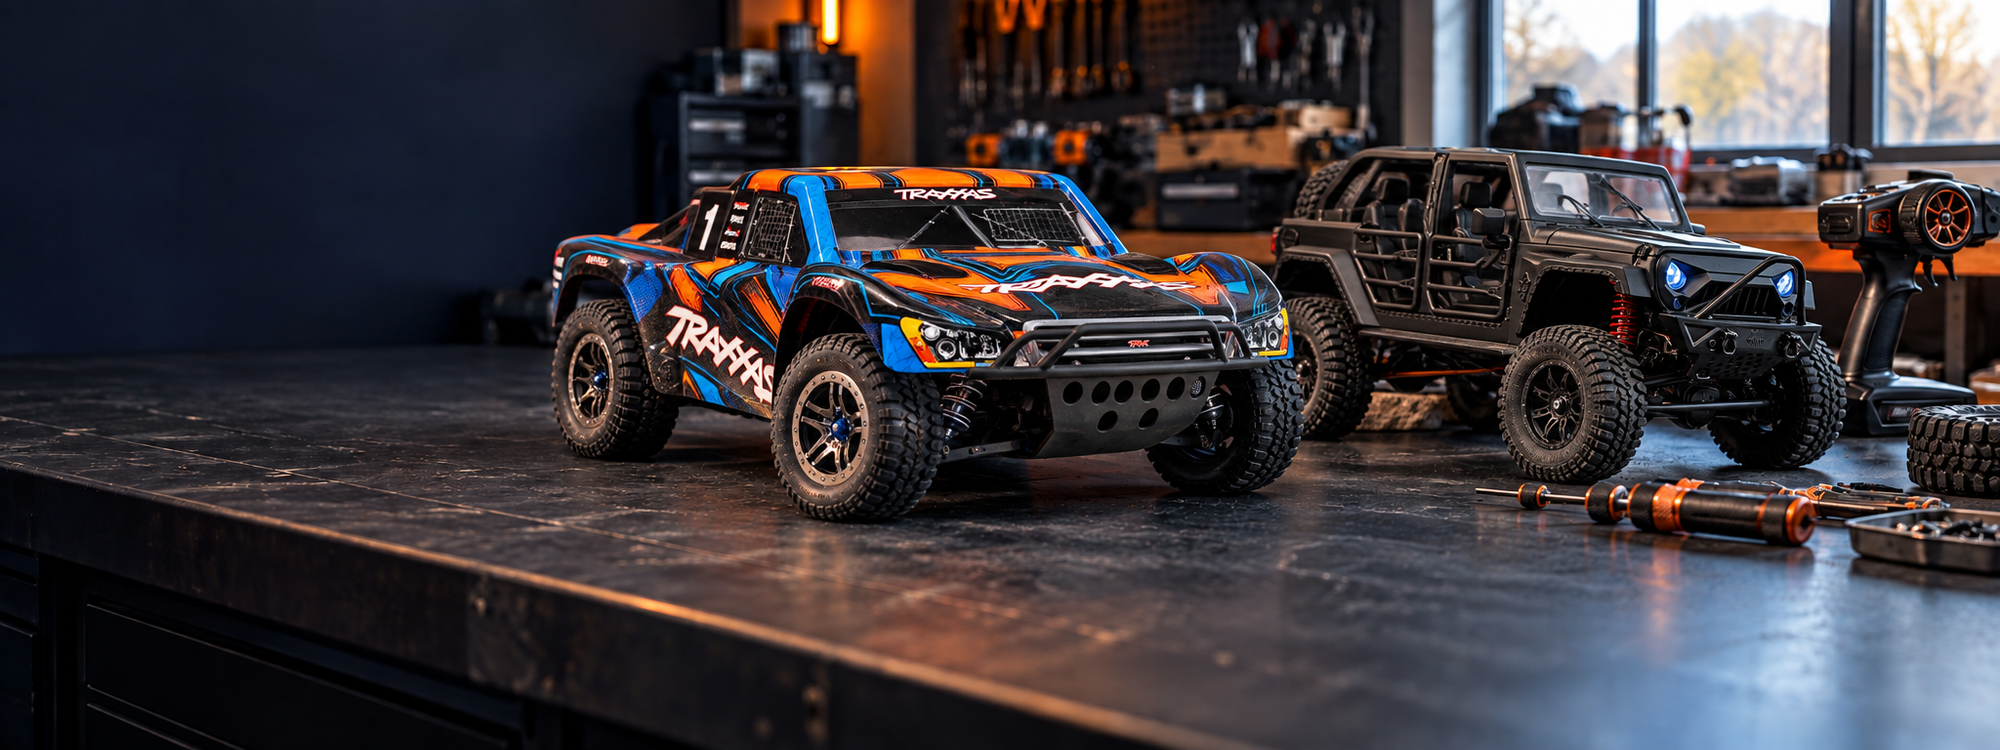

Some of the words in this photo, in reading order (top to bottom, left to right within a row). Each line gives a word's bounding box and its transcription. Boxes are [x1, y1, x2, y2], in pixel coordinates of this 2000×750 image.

[894, 188, 997, 200] TRAXXAS
[699, 204, 720, 251] 1
[957, 272, 1200, 294] TRAXXAS
